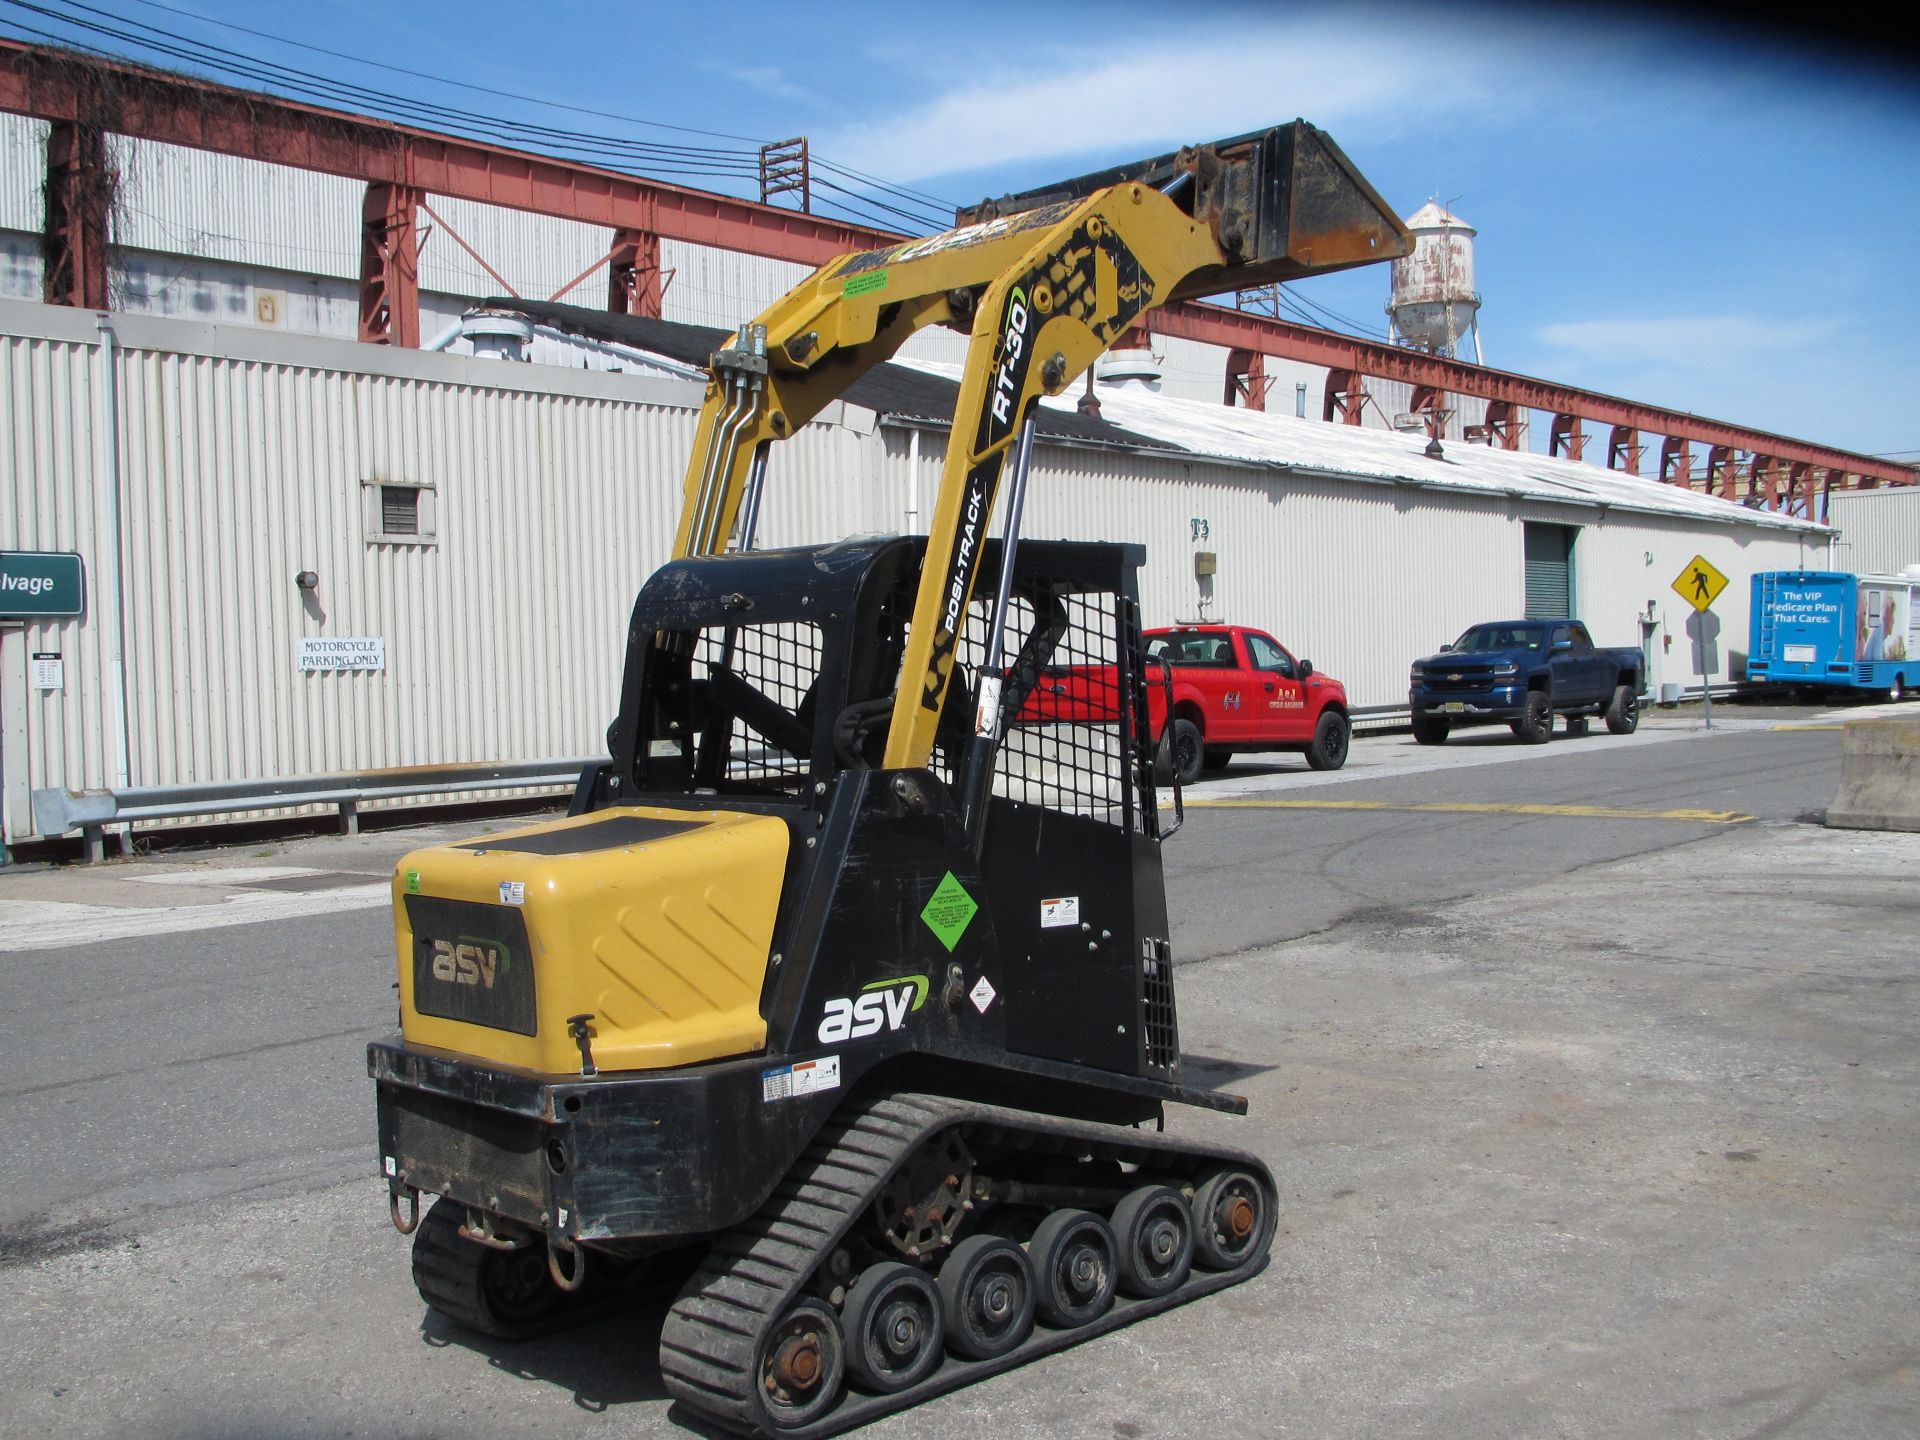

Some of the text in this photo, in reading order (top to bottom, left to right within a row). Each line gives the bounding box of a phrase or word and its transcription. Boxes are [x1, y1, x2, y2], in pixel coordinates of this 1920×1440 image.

[993, 303, 1028, 425] RT-30
[944, 488, 982, 634] POSI-TRACK
[0, 572, 54, 595] lvage
[1783, 592, 1822, 601] The VIP
[1814, 603, 1837, 612] Plan
[1775, 614, 1830, 624] That Cares.
[305, 641, 376, 652] MOTORCYCLE
[302, 655, 380, 667] PARKING ONLY
